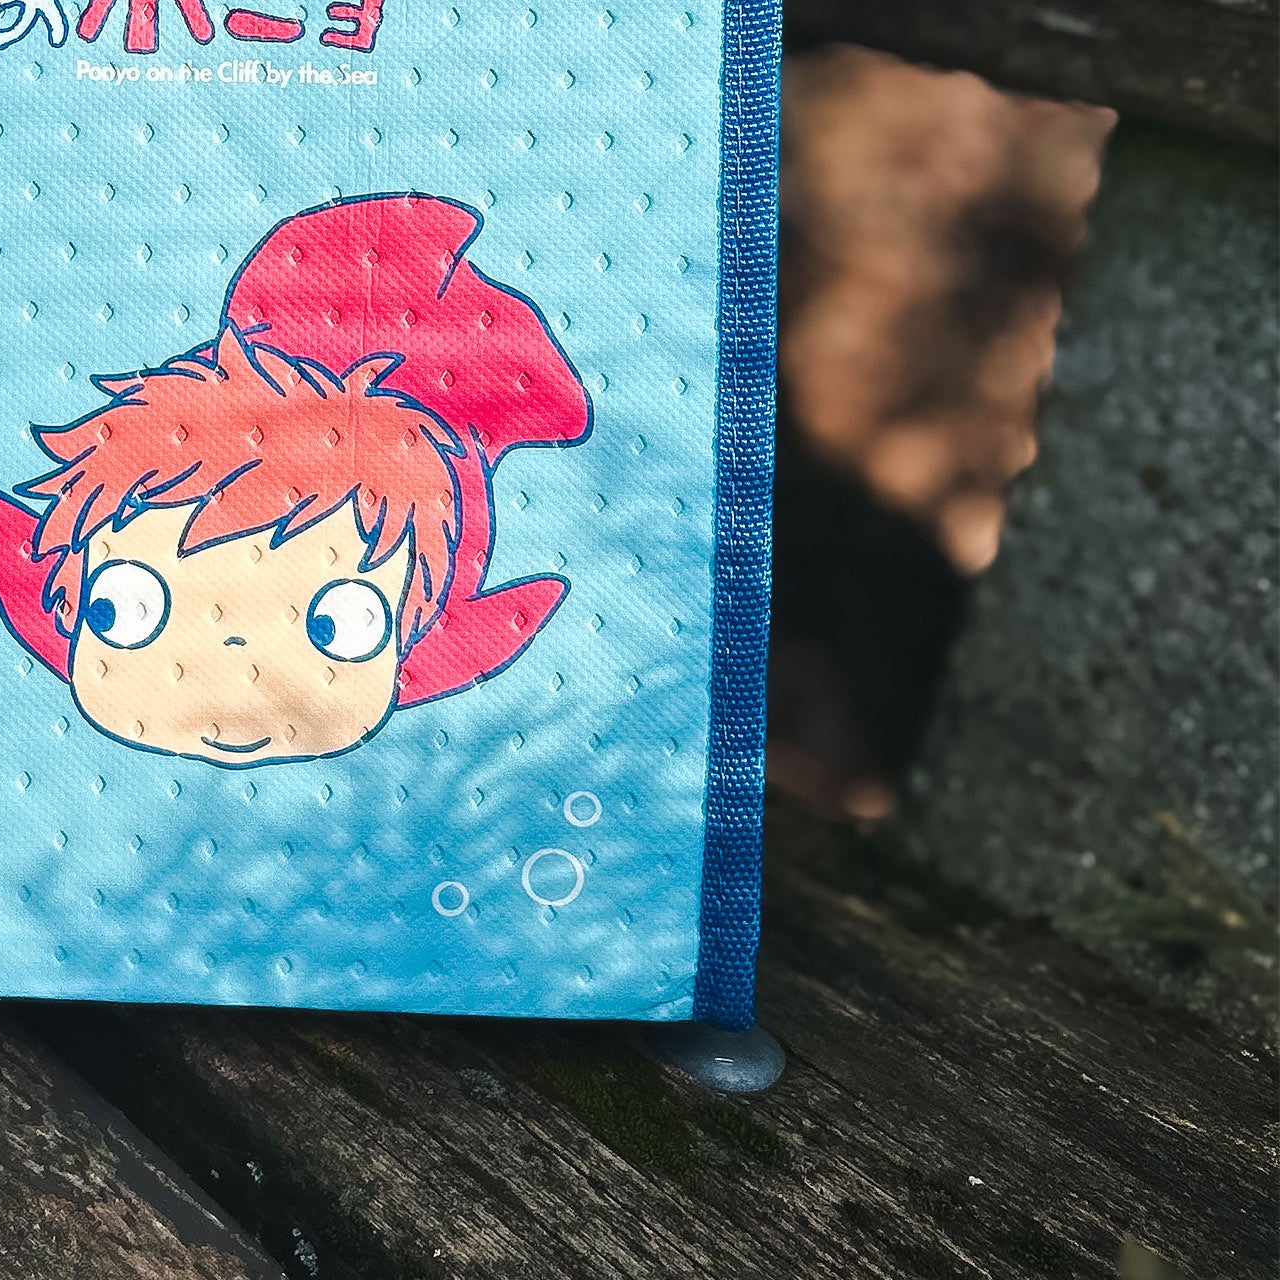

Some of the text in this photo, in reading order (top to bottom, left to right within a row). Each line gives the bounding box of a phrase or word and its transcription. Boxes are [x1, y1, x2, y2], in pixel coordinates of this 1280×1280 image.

[76, 59, 378, 88] Ponyo on the Cliff by the Sea
